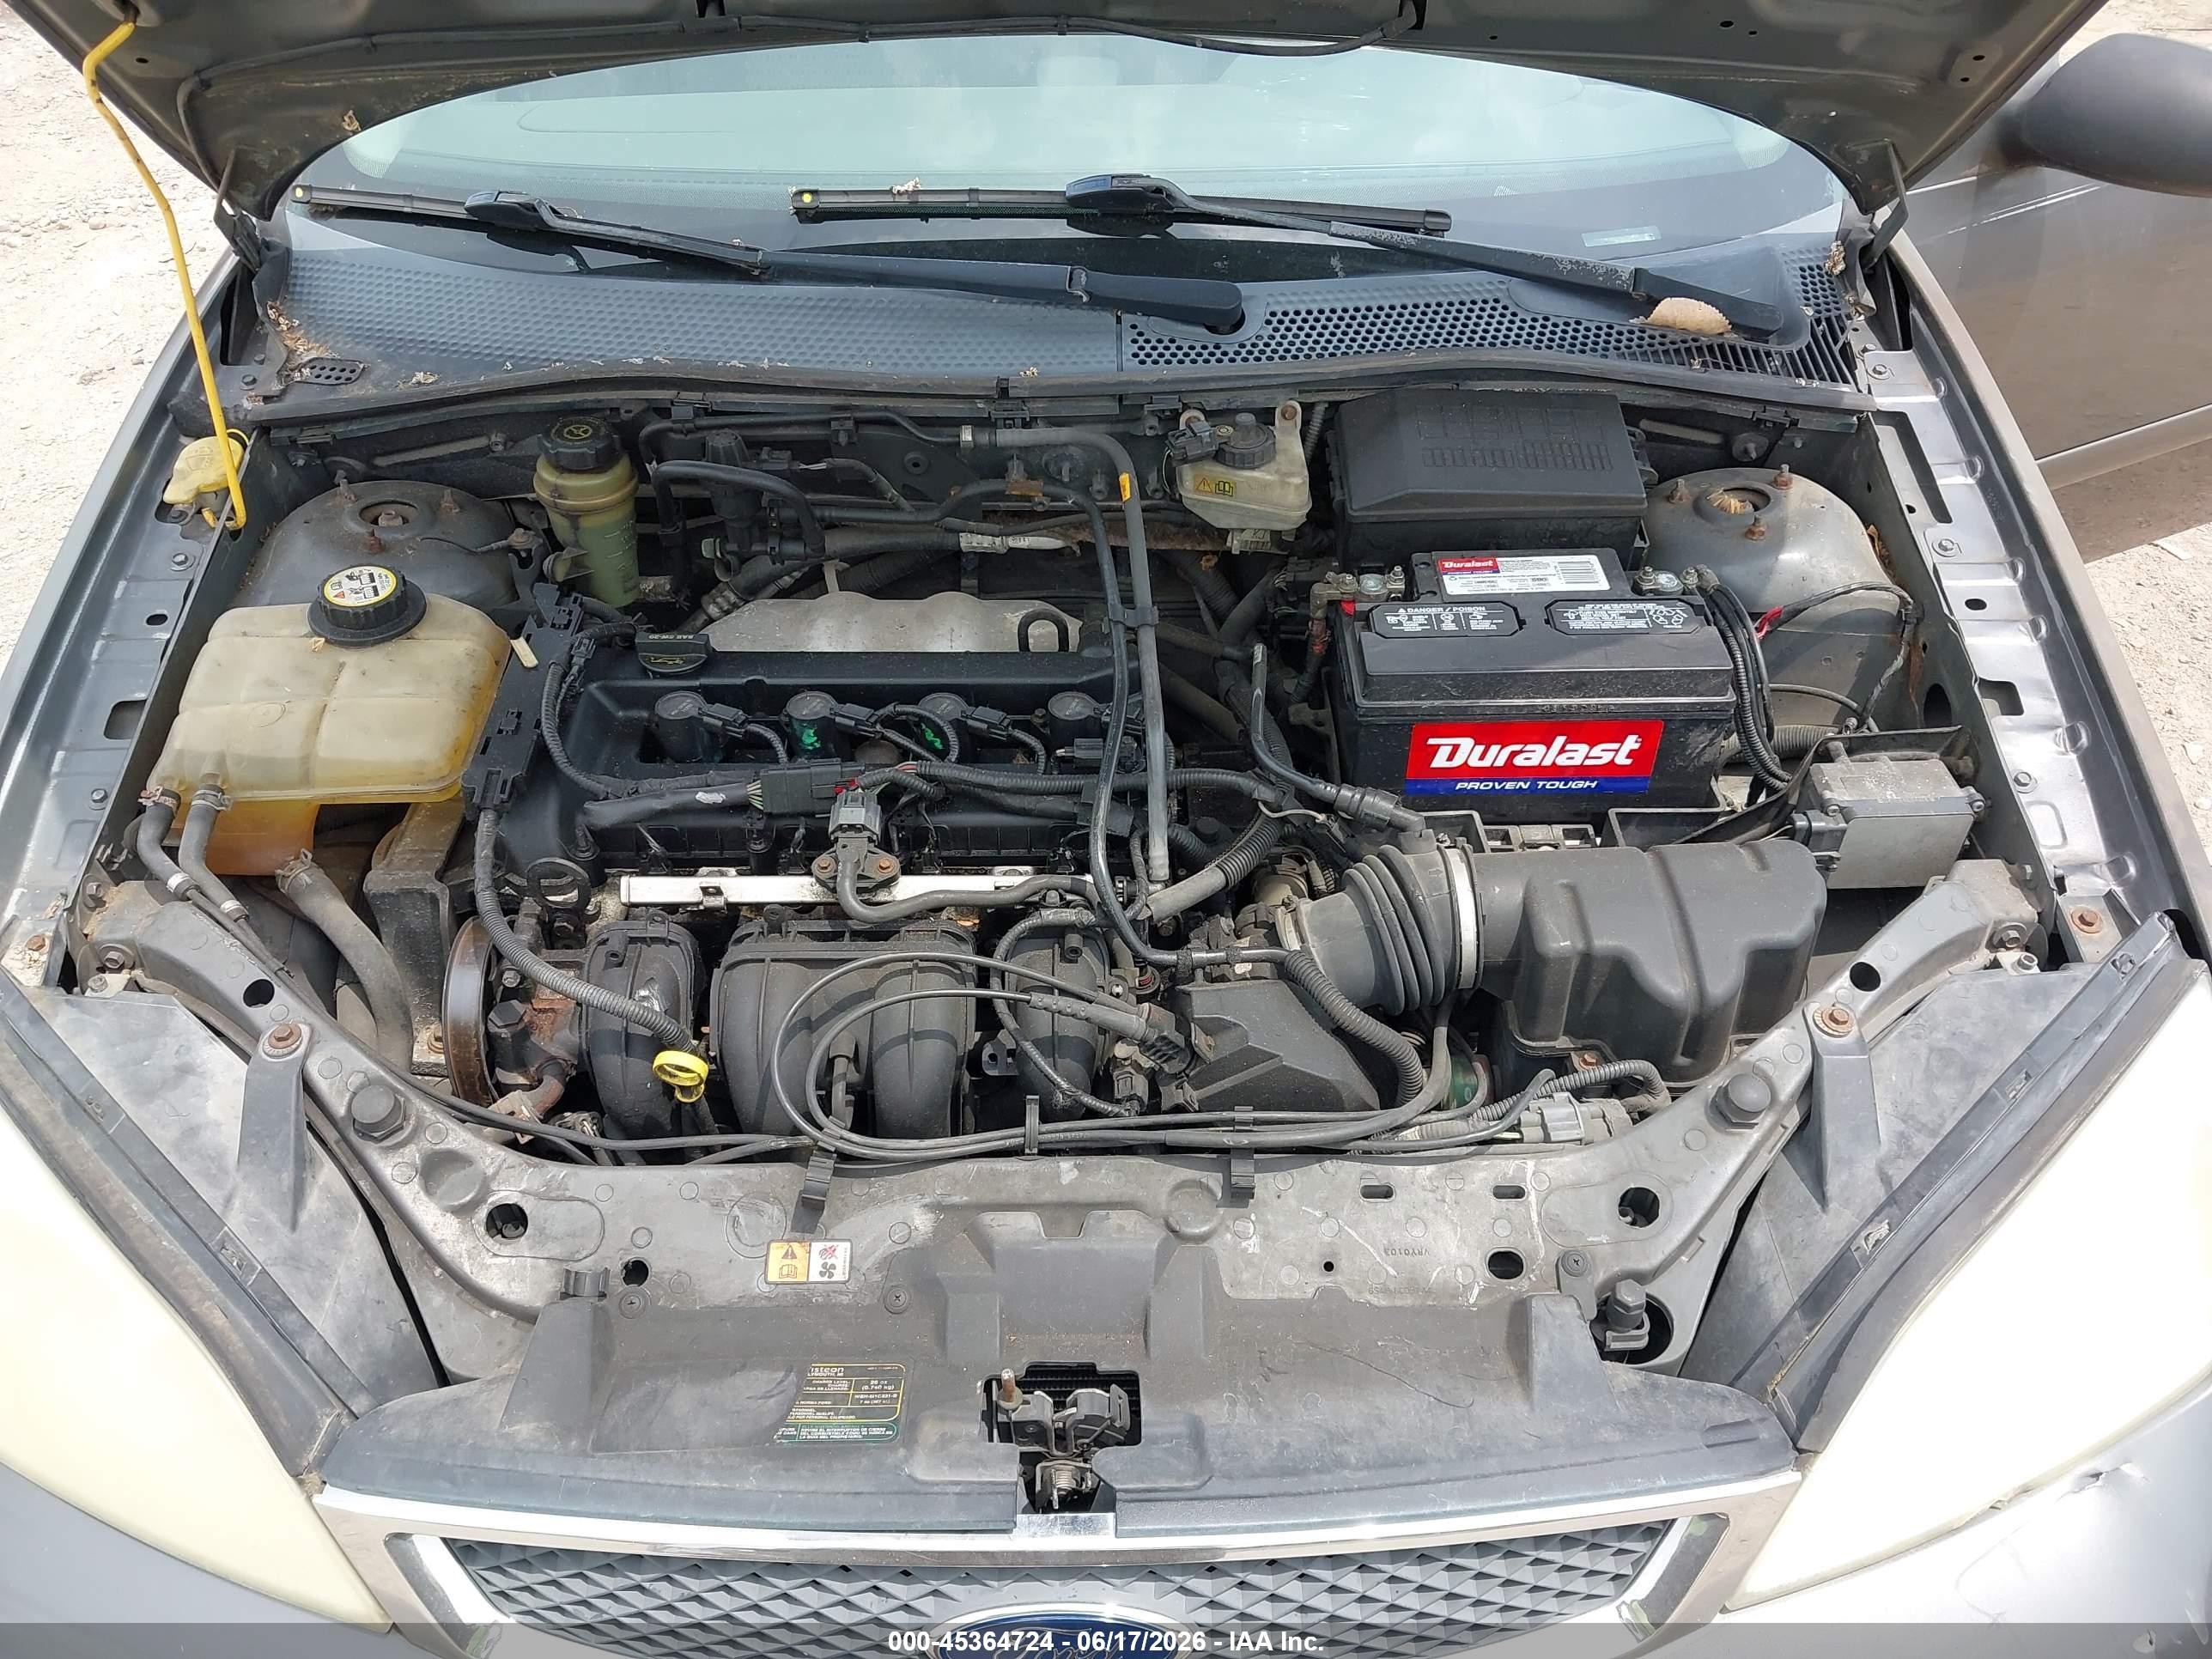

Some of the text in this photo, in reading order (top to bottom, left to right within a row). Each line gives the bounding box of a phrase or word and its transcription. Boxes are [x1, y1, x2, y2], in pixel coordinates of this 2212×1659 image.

[1442, 560, 1494, 568] Duralast
[1426, 734, 1641, 769] Duralast
[1455, 780, 1598, 790] PROVEN TOUGH
